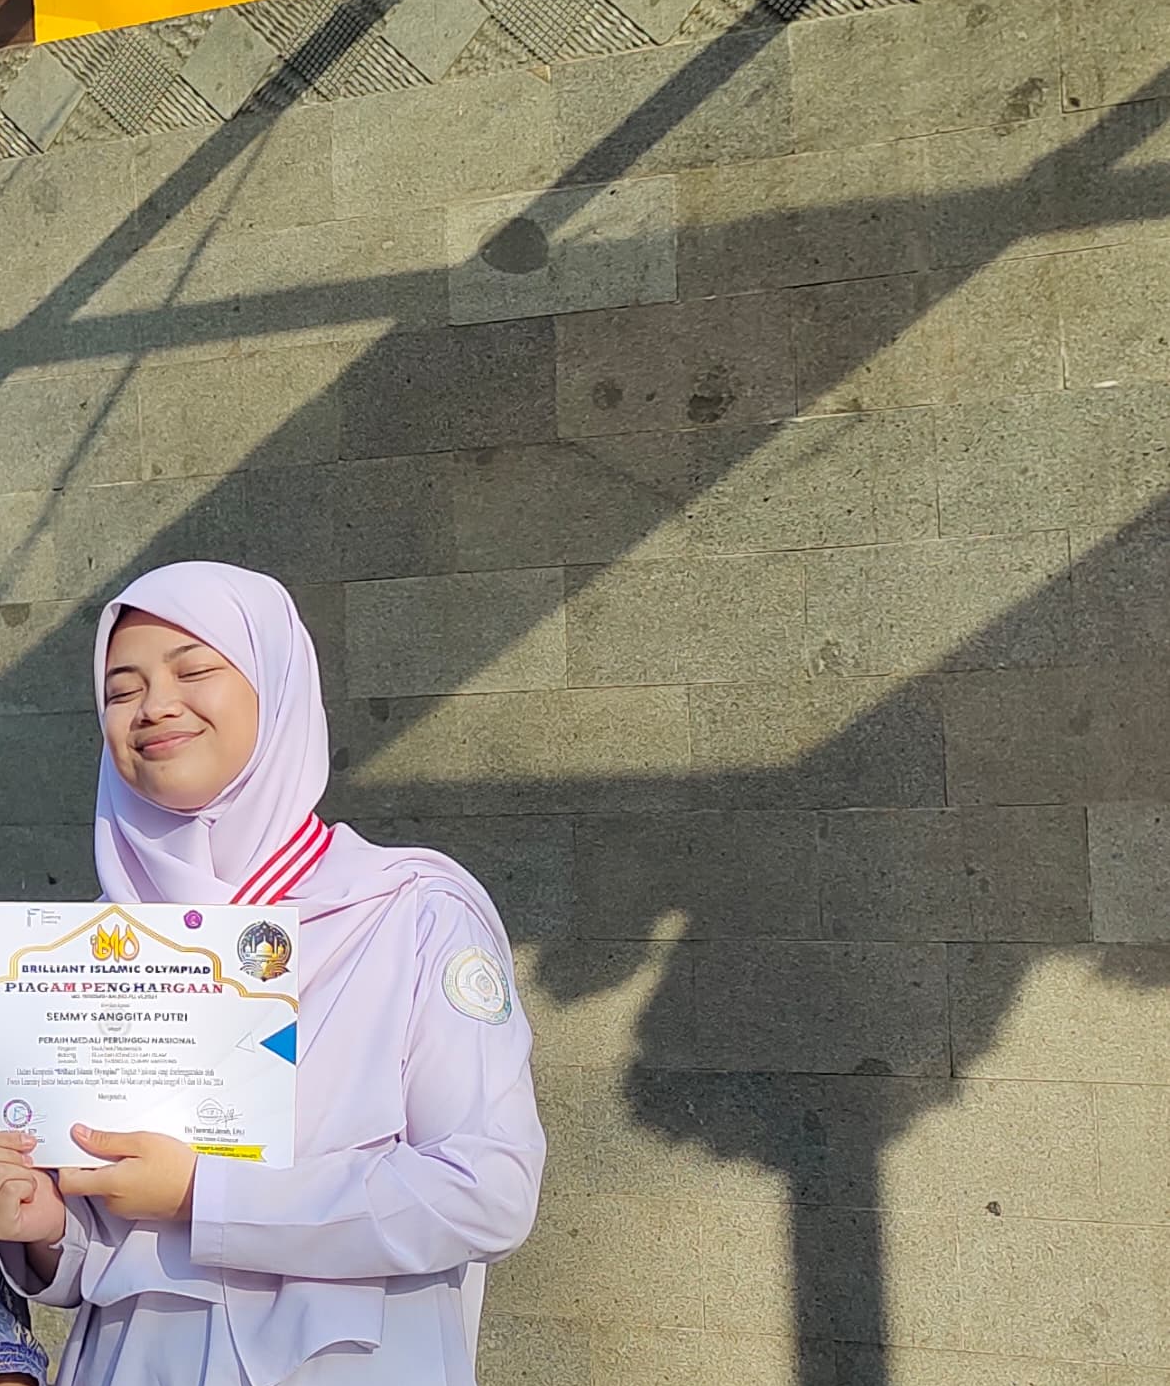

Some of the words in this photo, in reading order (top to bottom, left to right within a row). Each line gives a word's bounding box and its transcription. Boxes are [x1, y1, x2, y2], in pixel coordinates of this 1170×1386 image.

[21, 965, 85, 974] BRILLIANT
[90, 965, 141, 974] ISLAMIC
[145, 965, 211, 975] OLYMPIAD
[5, 982, 76, 993] PIAGAM
[81, 982, 223, 994] PENGHARGAAN
[46, 1012, 87, 1022] SEMMY
[90, 1012, 152, 1022] SANGGITA
[154, 1012, 188, 1022] PUTRI
[151, 1037, 196, 1045] NASIONAL
